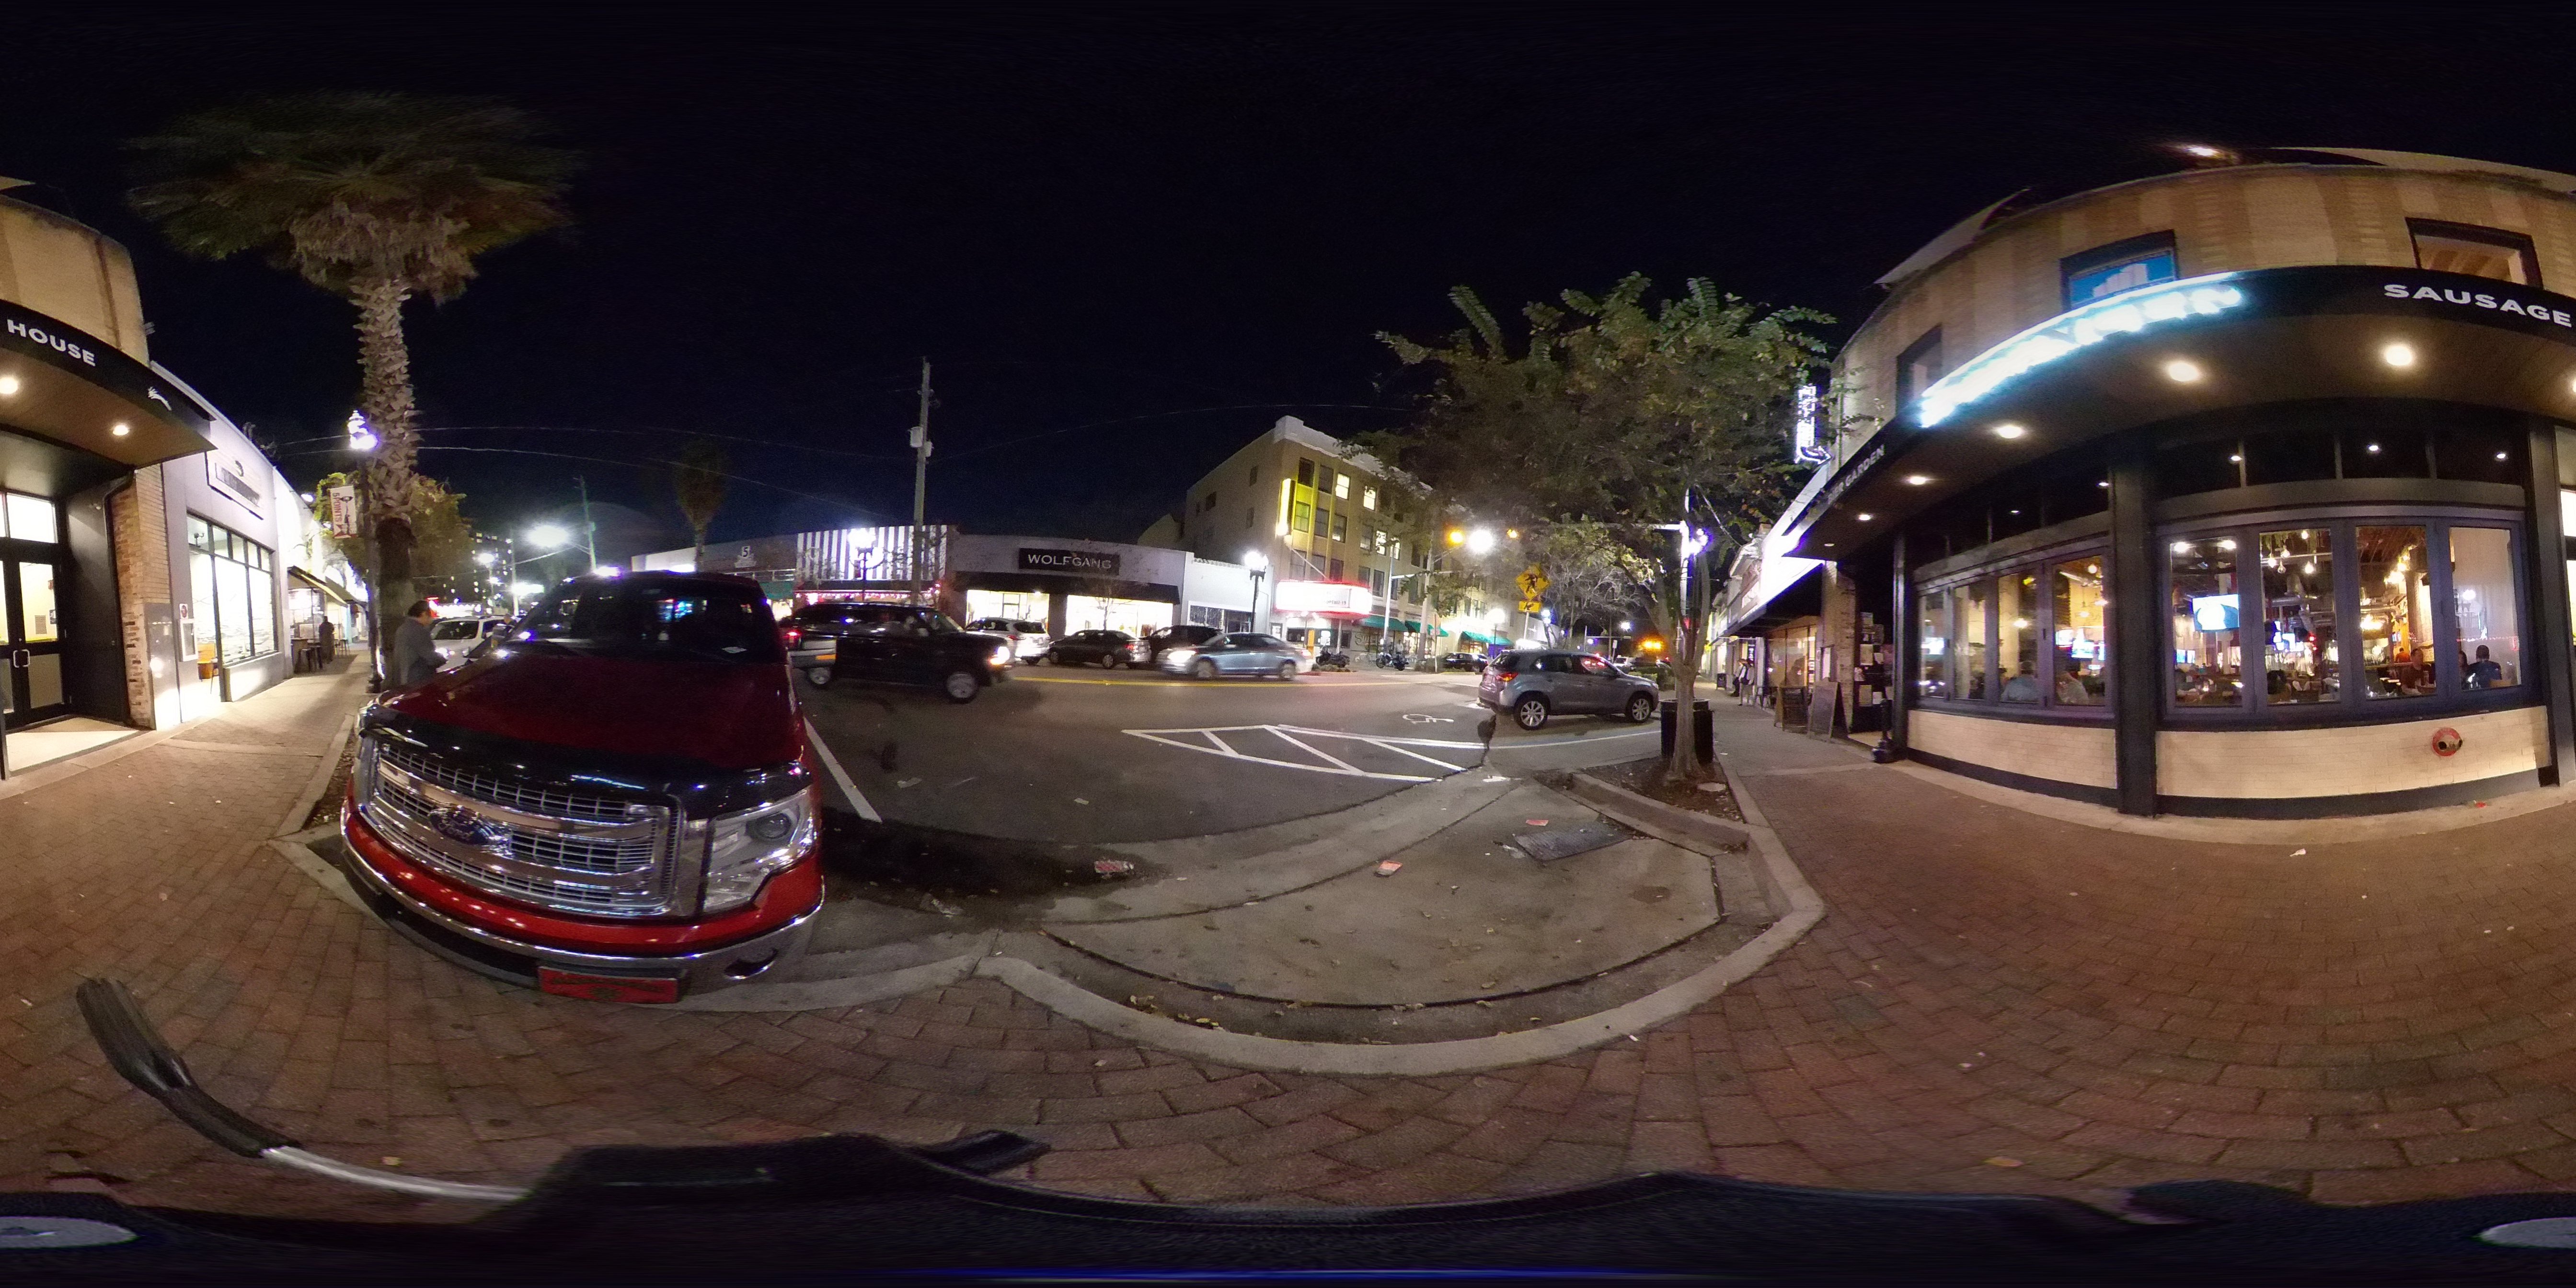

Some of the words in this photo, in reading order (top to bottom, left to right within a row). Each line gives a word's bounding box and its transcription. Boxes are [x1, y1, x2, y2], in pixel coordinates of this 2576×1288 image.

[2384, 284, 2572, 328] SAUSAGE
[7, 319, 96, 367] HOUSE
[1846, 444, 1885, 487] GARDEN
[1028, 554, 1112, 569] WOLFGANG
